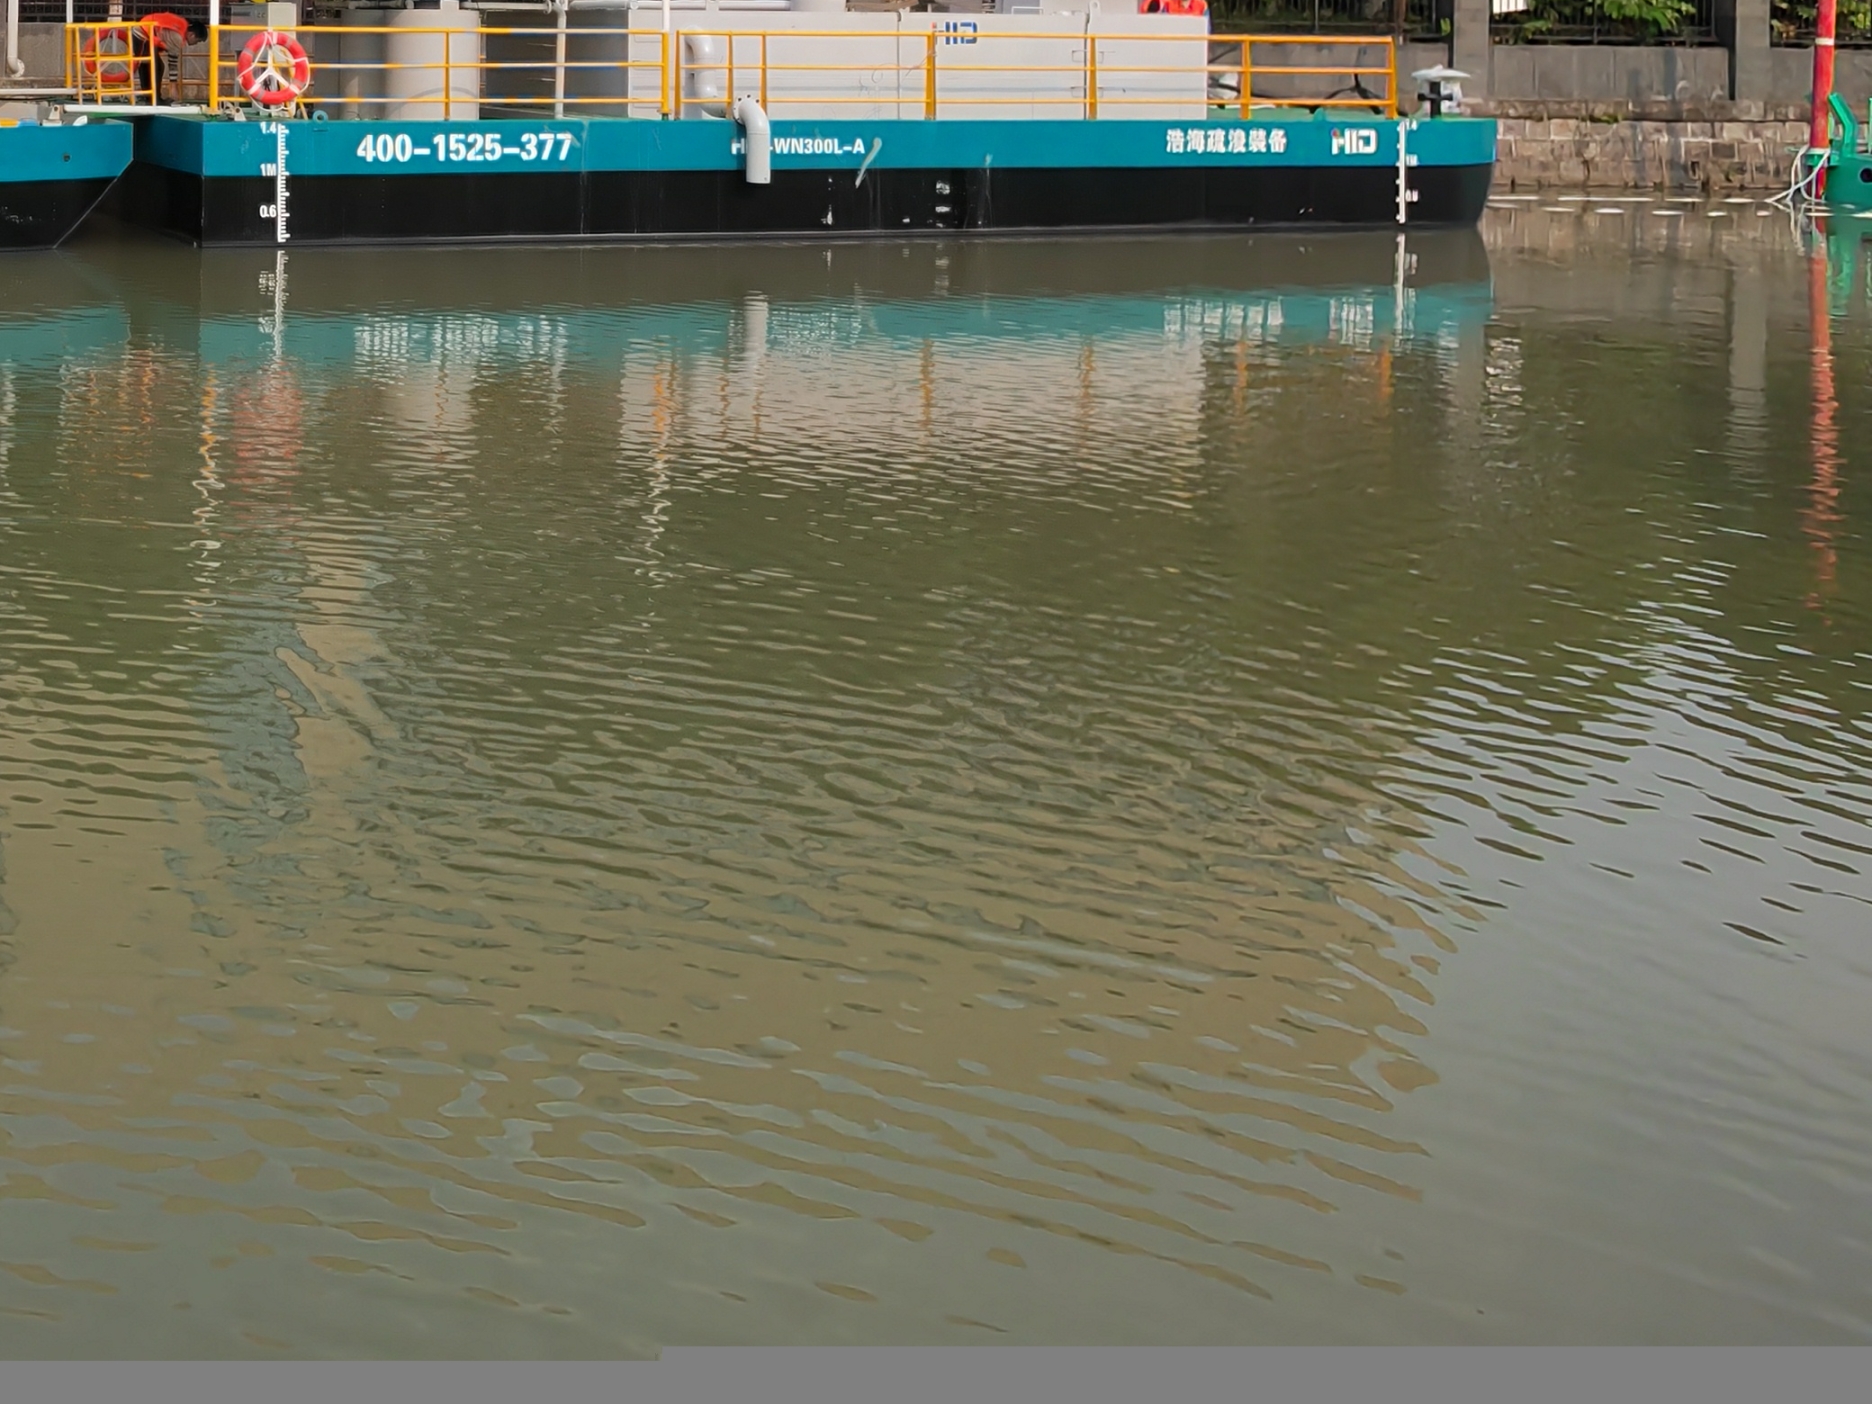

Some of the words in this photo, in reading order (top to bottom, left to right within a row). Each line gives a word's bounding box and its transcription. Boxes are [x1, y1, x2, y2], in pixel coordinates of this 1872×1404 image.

[260, 121, 277, 134] 1.4
[356, 133, 571, 162] 400-1525-377
[731, 137, 865, 155] H-WN300L-A
[1166, 128, 1287, 154] 浩海疏浚装备
[260, 163, 277, 177] 1M
[259, 204, 277, 218] 0.6
